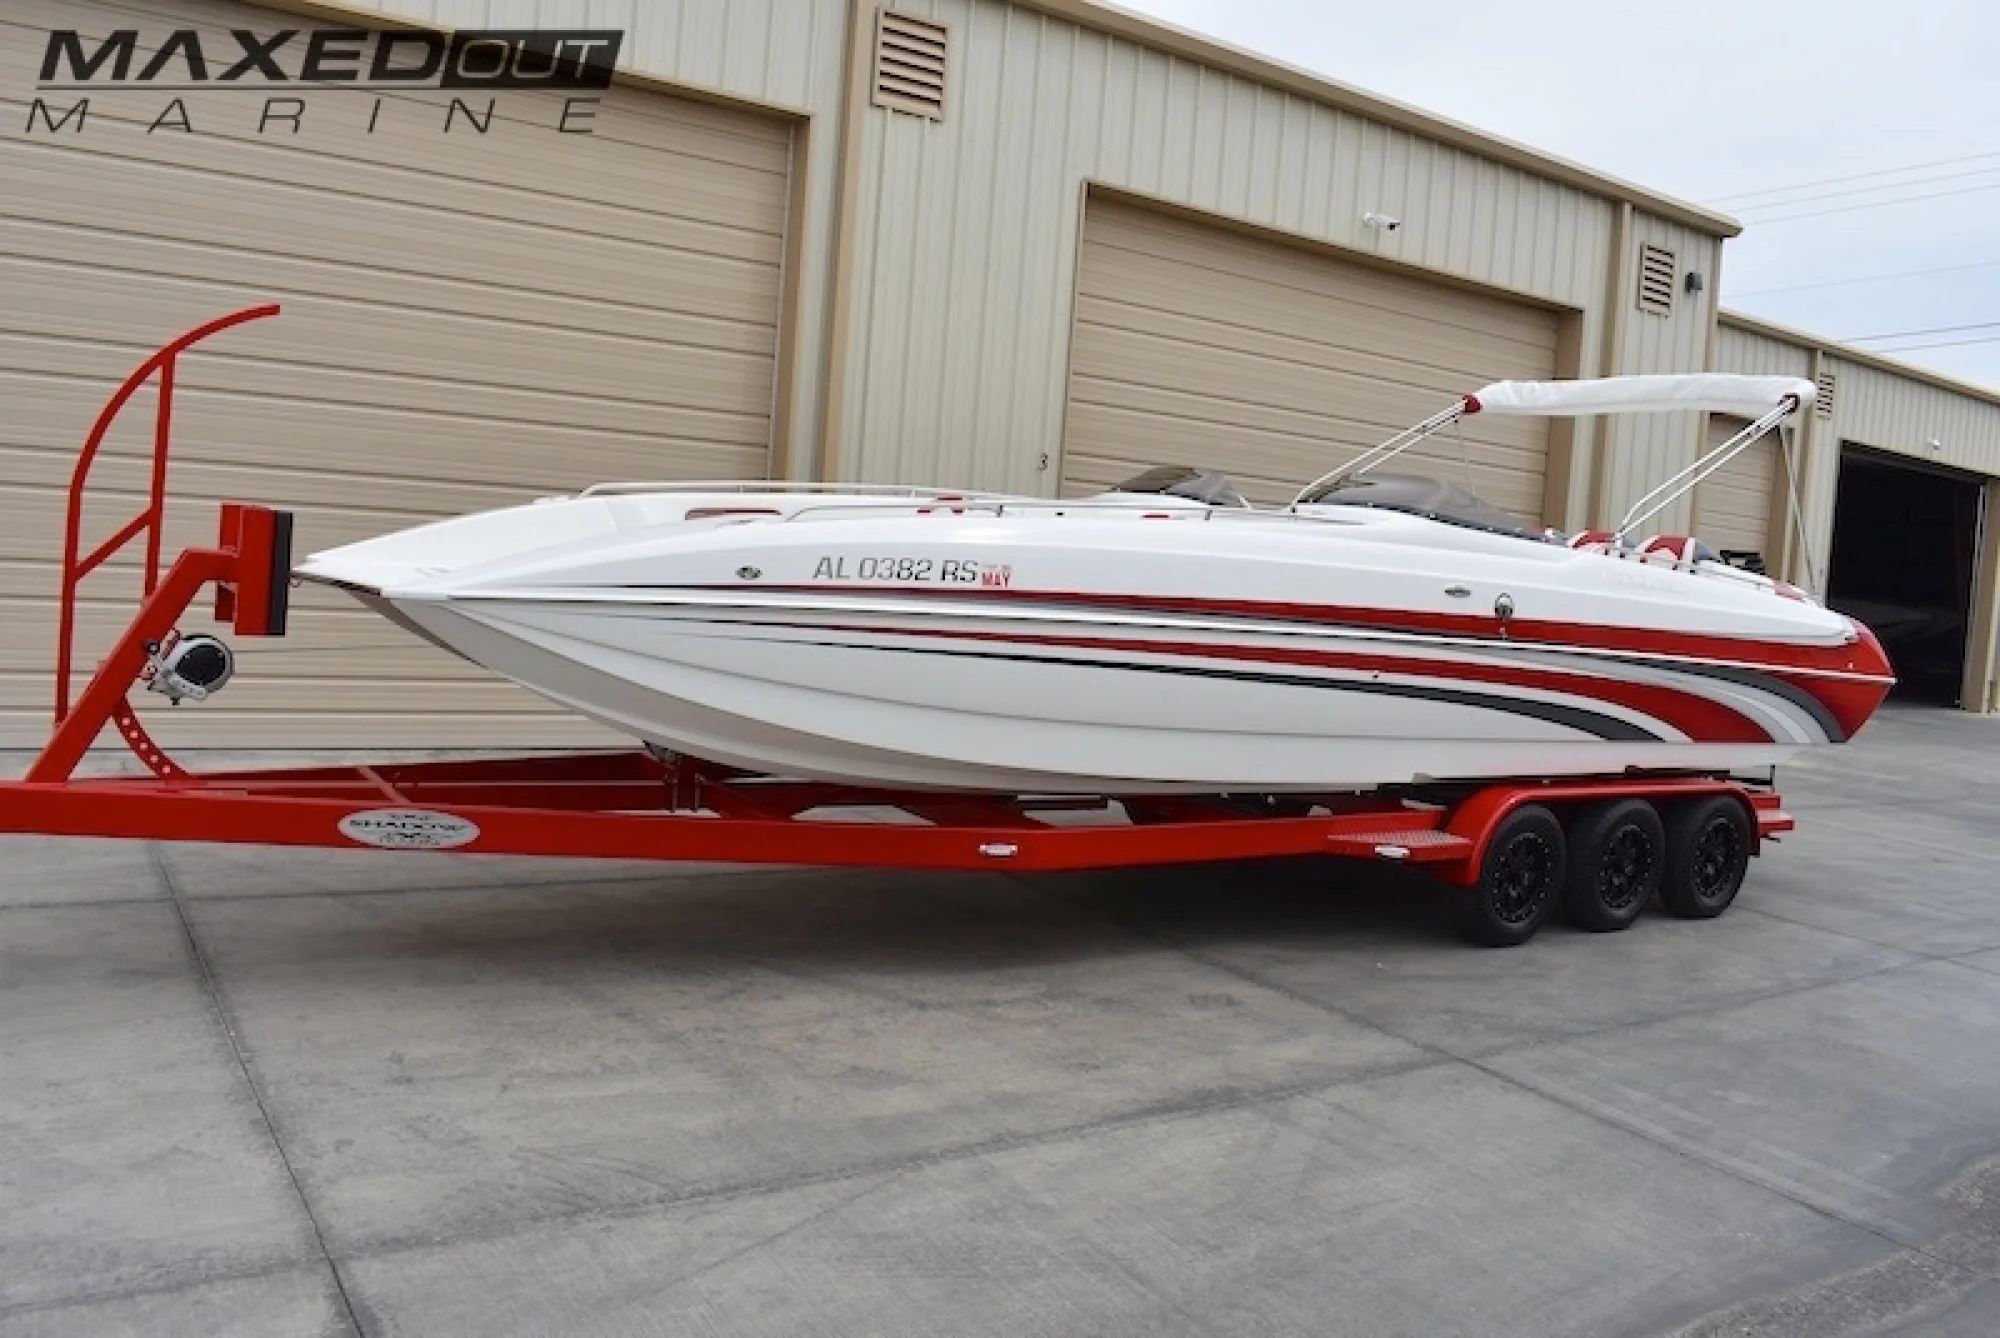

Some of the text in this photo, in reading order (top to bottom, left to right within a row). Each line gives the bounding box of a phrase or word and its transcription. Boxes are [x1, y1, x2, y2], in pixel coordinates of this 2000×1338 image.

[1036, 452, 1049, 471] 3
[812, 556, 978, 582] AL 0382 RS
